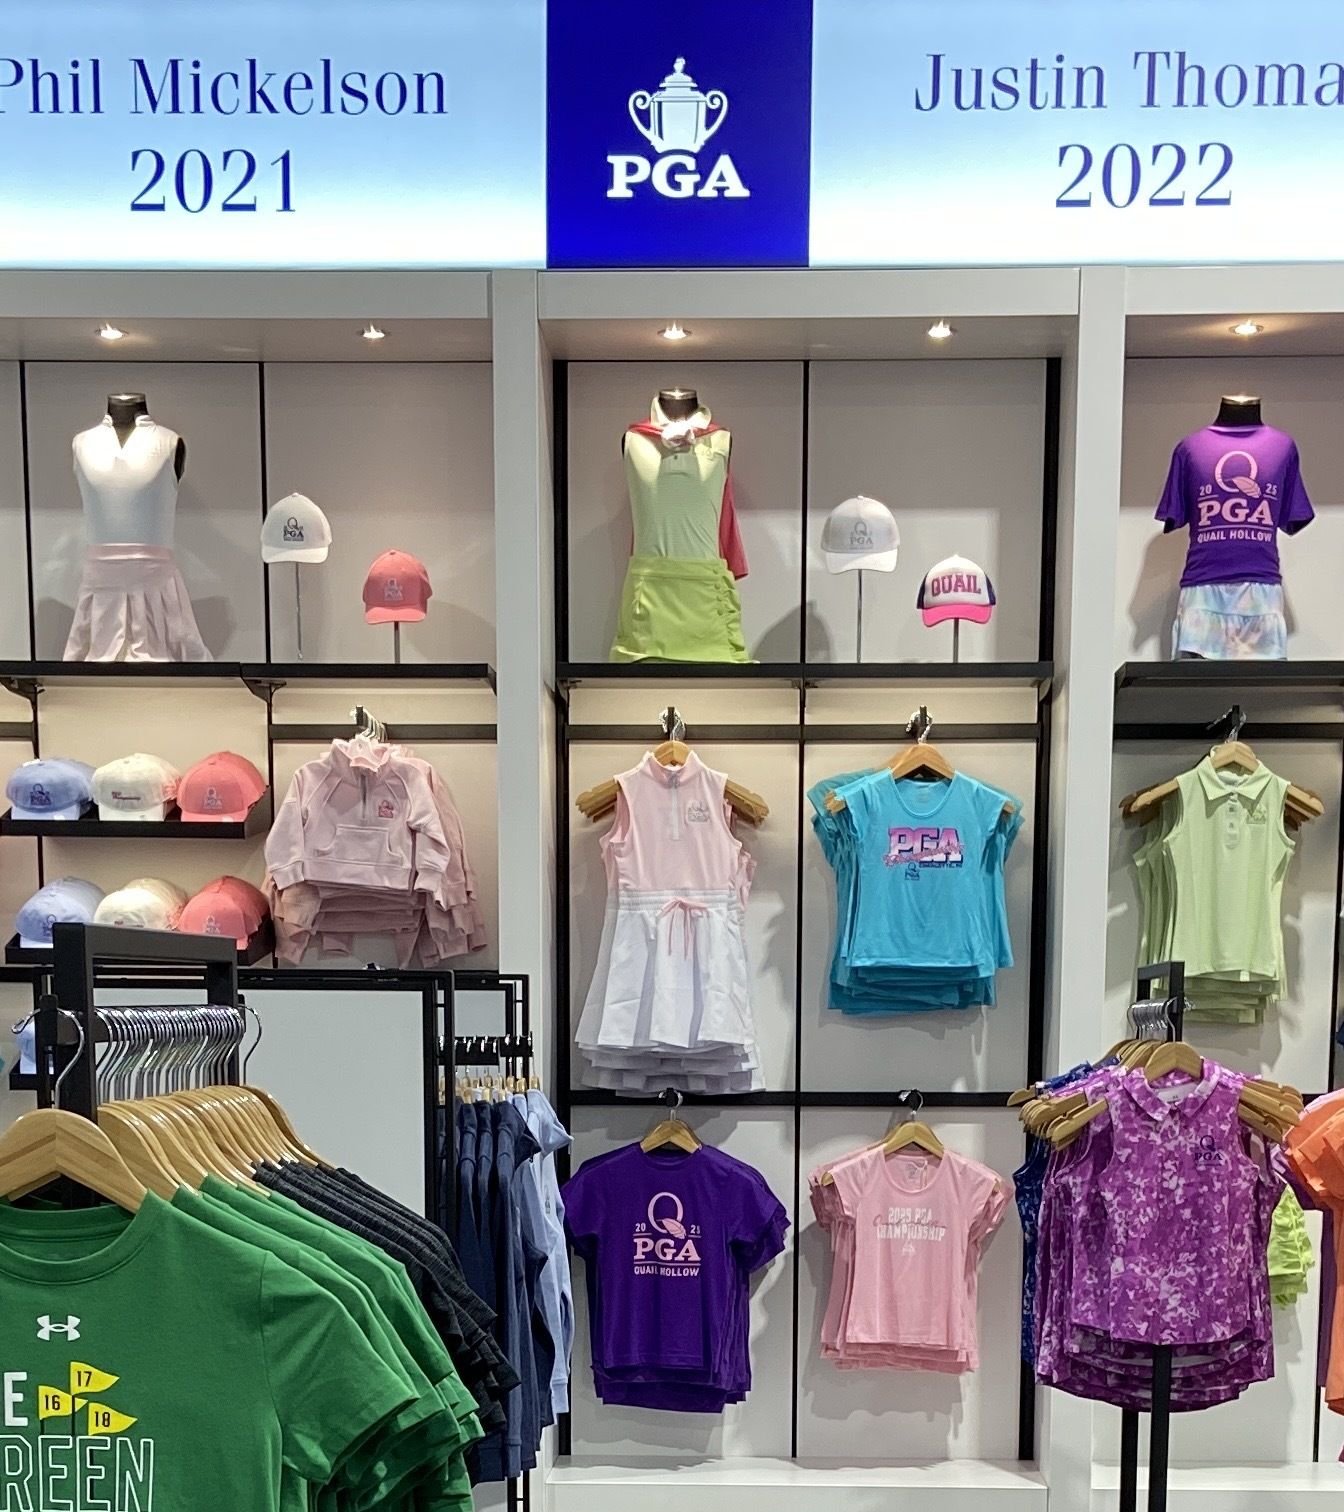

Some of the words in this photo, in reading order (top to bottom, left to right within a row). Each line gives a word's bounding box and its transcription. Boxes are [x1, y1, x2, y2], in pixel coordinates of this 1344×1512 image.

[129, 58, 448, 114] Mickelson
[914, 54, 1108, 111] Justin
[130, 149, 296, 213] 2021
[607, 154, 750, 198] PGA
[1056, 142, 1234, 208] 2022
[1199, 484, 1213, 496] 20
[1265, 483, 1278, 495] 25
[1197, 498, 1274, 526] PGA
[850, 537, 873, 545] PGA
[1197, 530, 1226, 543] QUAIL
[1229, 530, 1272, 542] HOLLOW
[931, 574, 981, 597] QUAIL
[888, 827, 964, 863] PGA
[635, 1223, 646, 1232] 20
[633, 1238, 701, 1261] PGA
[634, 1266, 658, 1275] QUAIL
[660, 1267, 700, 1276] HOLLOW
[77, 1370, 92, 1387] 17
[44, 1395, 60, 1411] 16
[95, 1411, 111, 1428] 18
